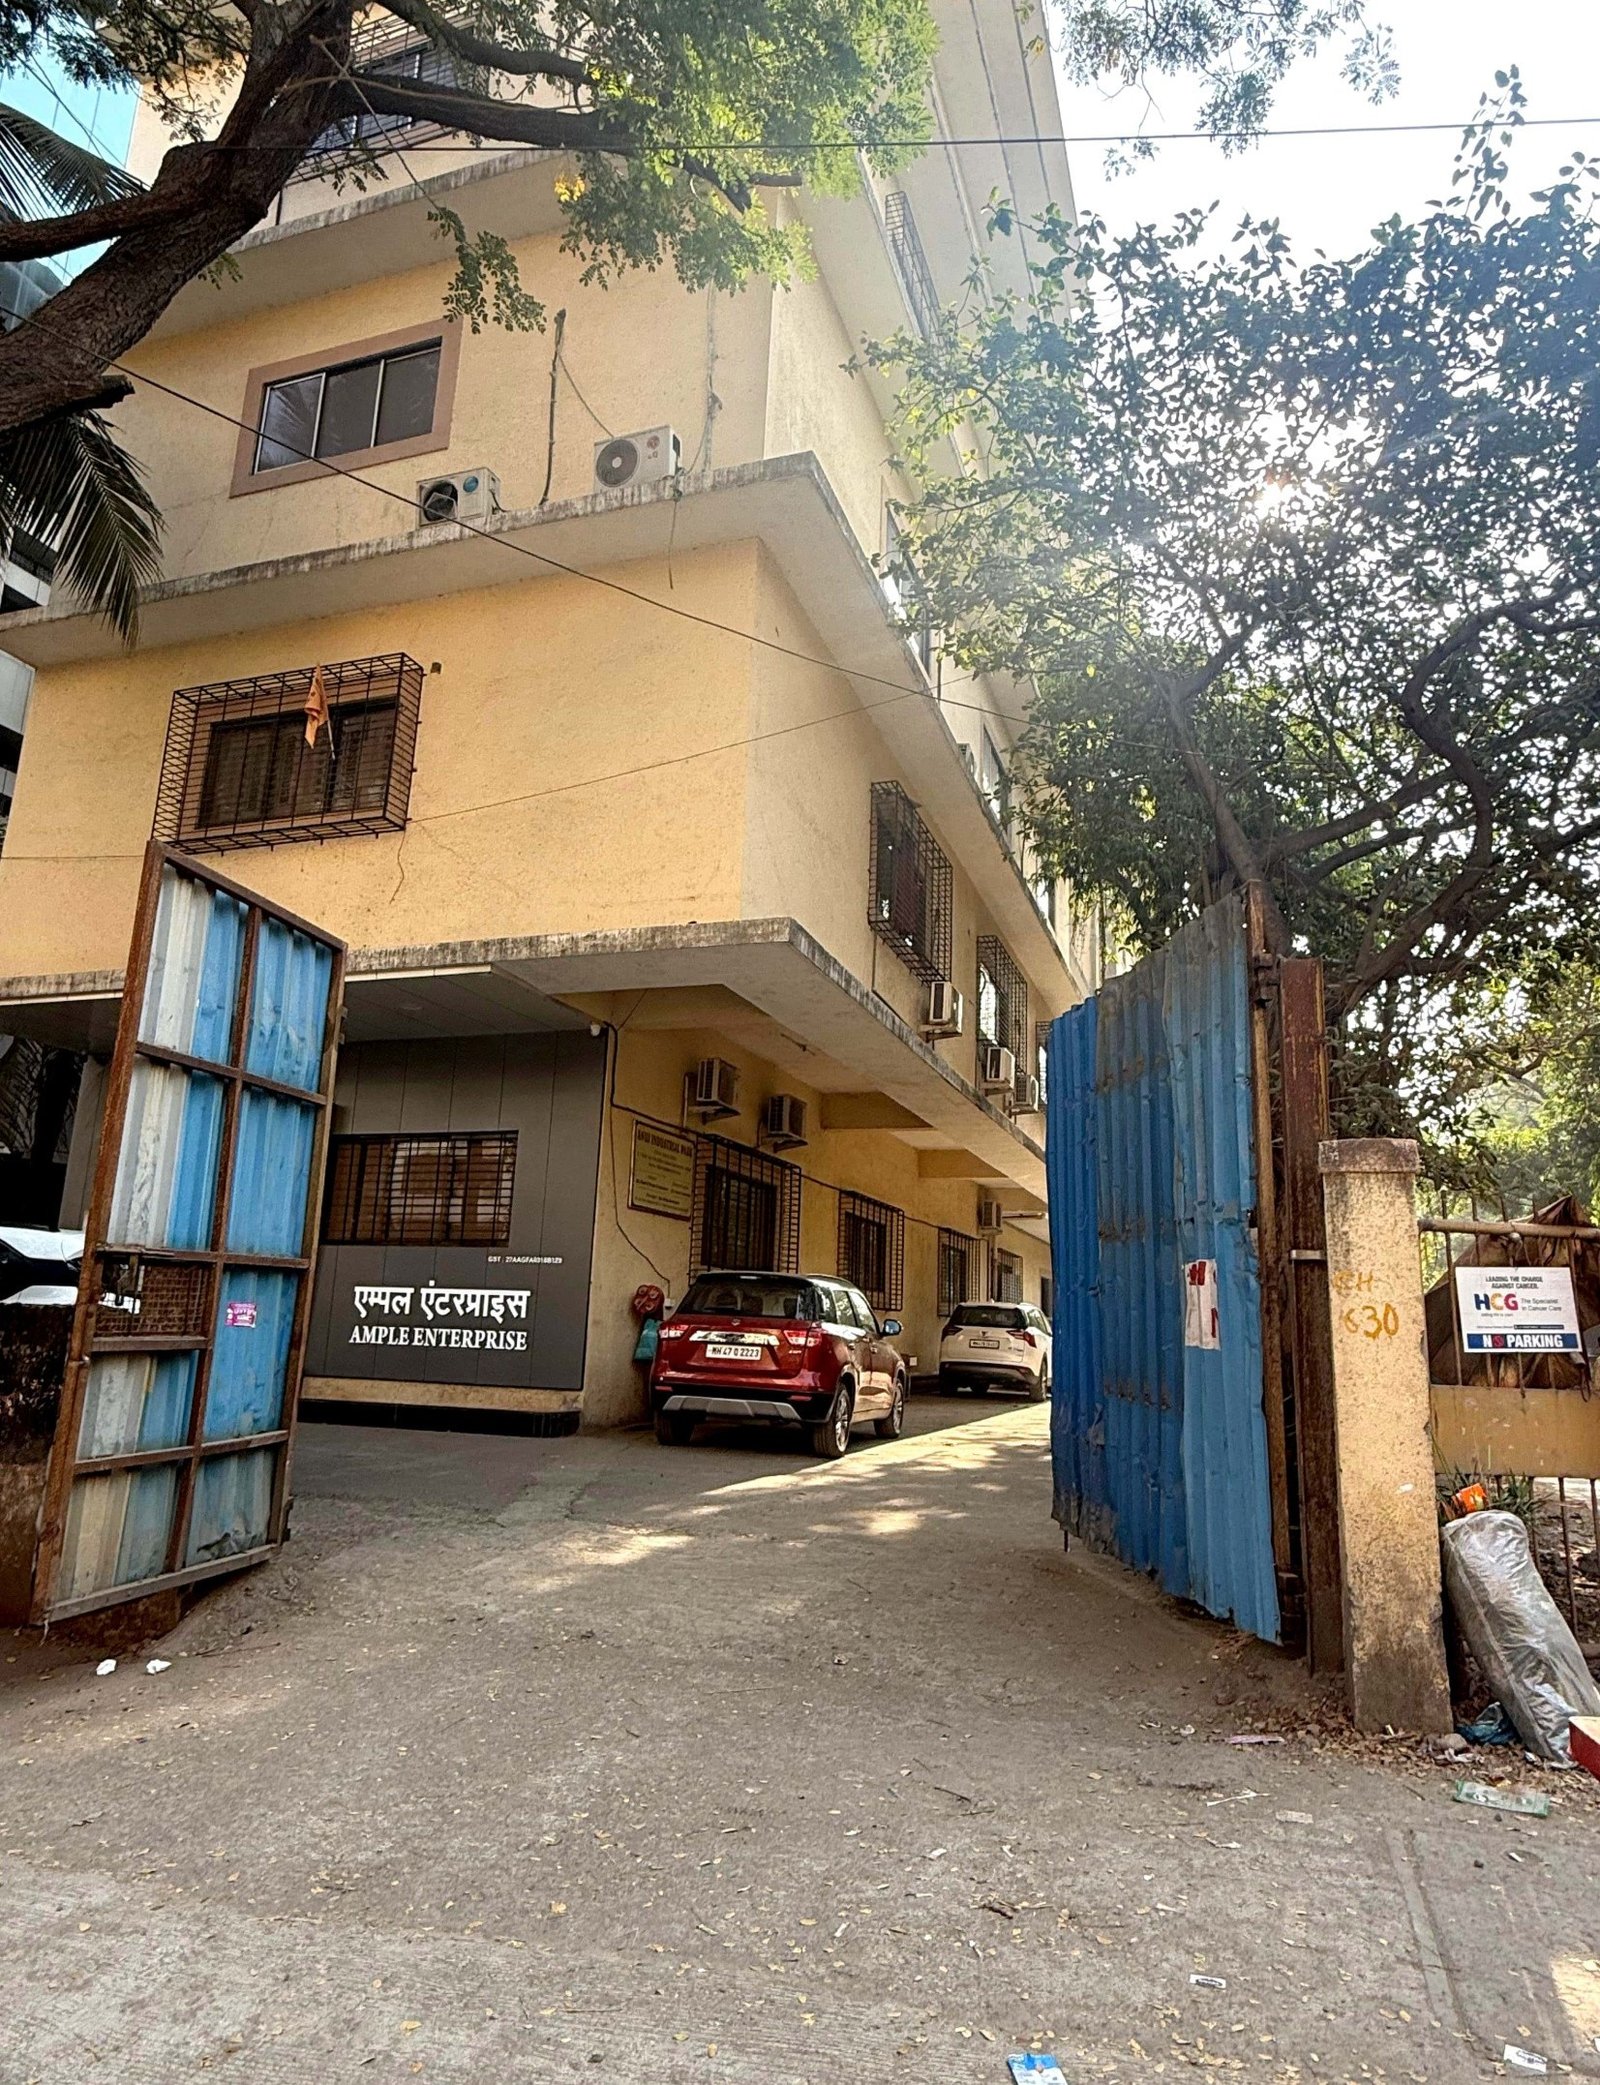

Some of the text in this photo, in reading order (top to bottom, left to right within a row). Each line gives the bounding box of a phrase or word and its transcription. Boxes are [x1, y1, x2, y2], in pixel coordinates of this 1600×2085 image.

[354, 1280, 531, 1324] एम्पल एंटरप्राइस
[1474, 1293, 1518, 1310] HCG
[349, 1325, 528, 1350] AMPLE ENTERPRISE
[1507, 1334, 1563, 1348] PARKING
[723, 1347, 732, 1355] 47
[740, 1349, 759, 1357] 2223
